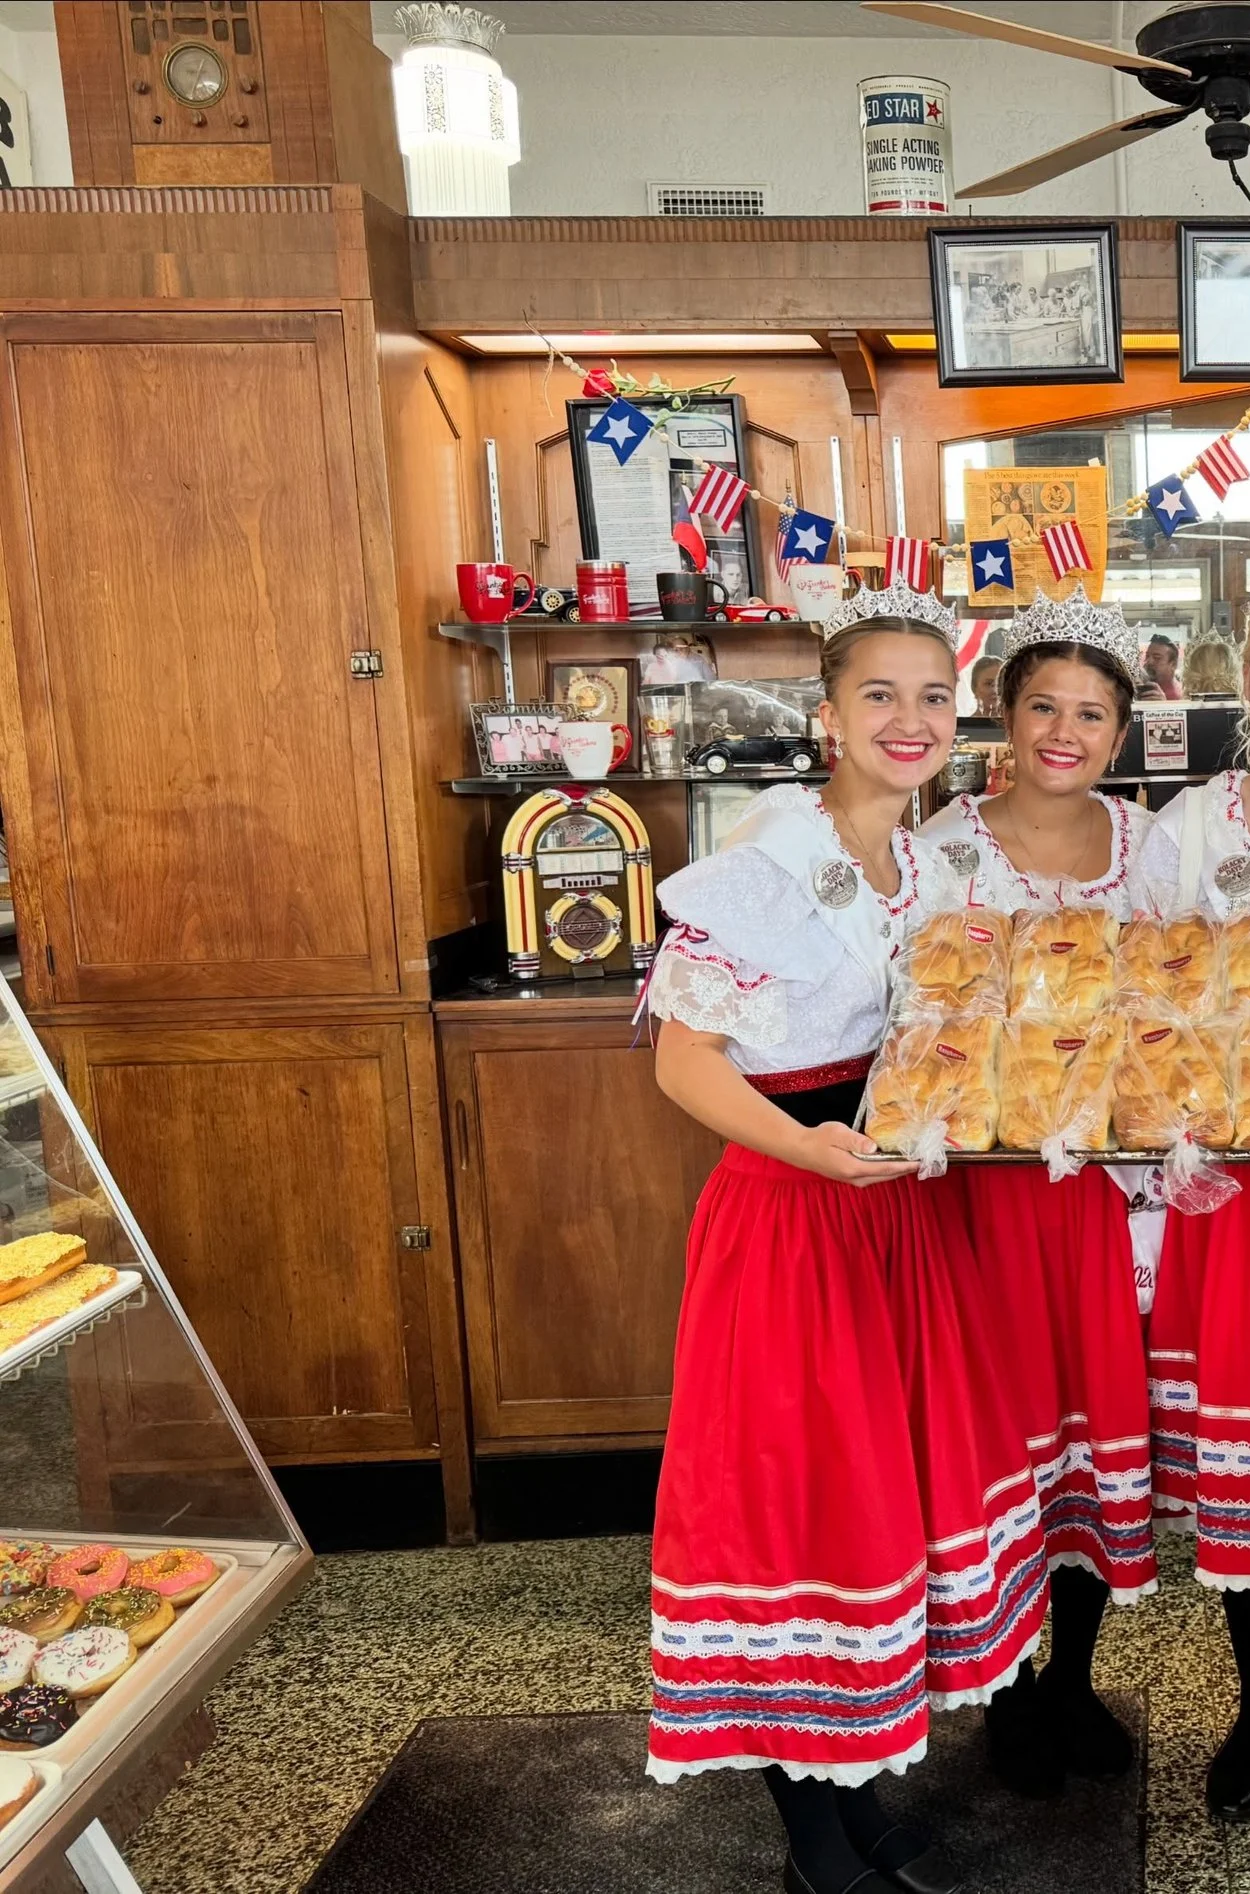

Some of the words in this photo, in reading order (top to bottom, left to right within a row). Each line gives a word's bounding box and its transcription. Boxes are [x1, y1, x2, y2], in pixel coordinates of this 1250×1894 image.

[866, 99, 880, 120] ED
[884, 98, 920, 118] STAR
[866, 138, 898, 156] SINGLE
[902, 138, 940, 156] ACTING
[867, 156, 897, 174] AKING
[901, 156, 944, 174] POWDER
[967, 927, 993, 941] Raspberry
